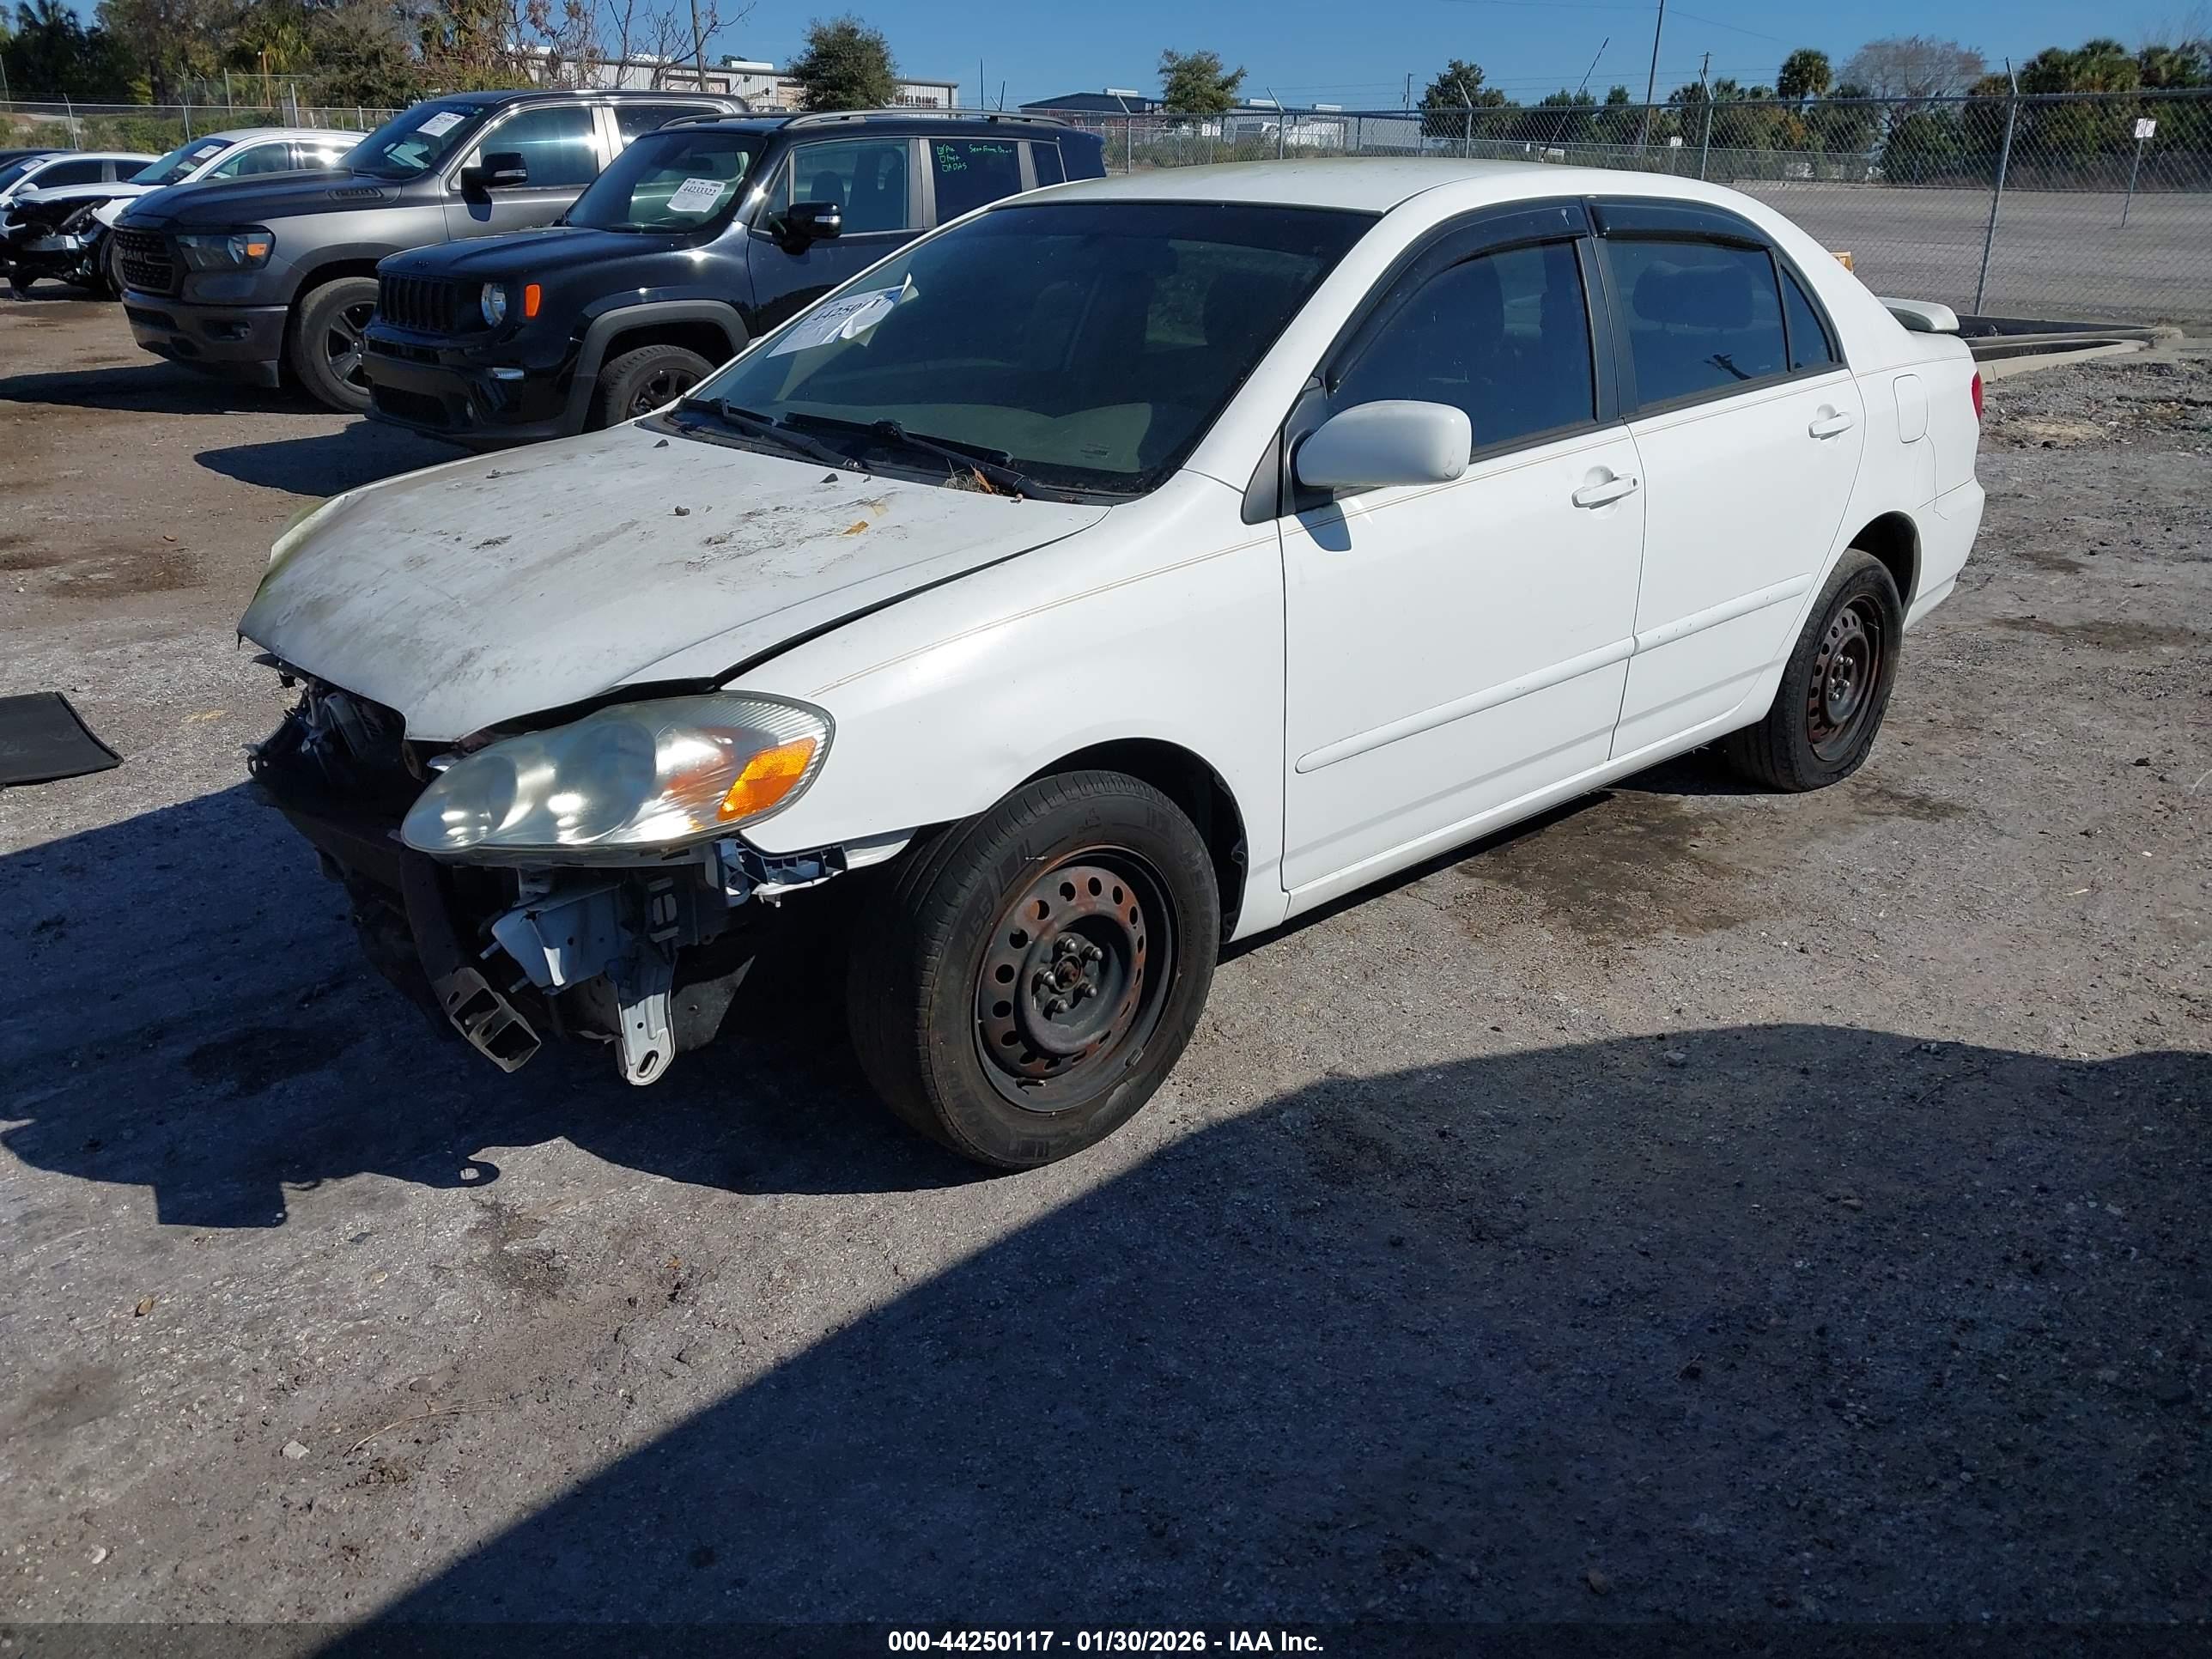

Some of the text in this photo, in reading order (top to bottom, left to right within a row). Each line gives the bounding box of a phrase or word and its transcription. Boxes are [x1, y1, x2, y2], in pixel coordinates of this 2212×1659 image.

[895, 95, 939, 107] WELDING
[683, 185, 717, 196] 44233322
[118, 248, 143, 263] RAM
